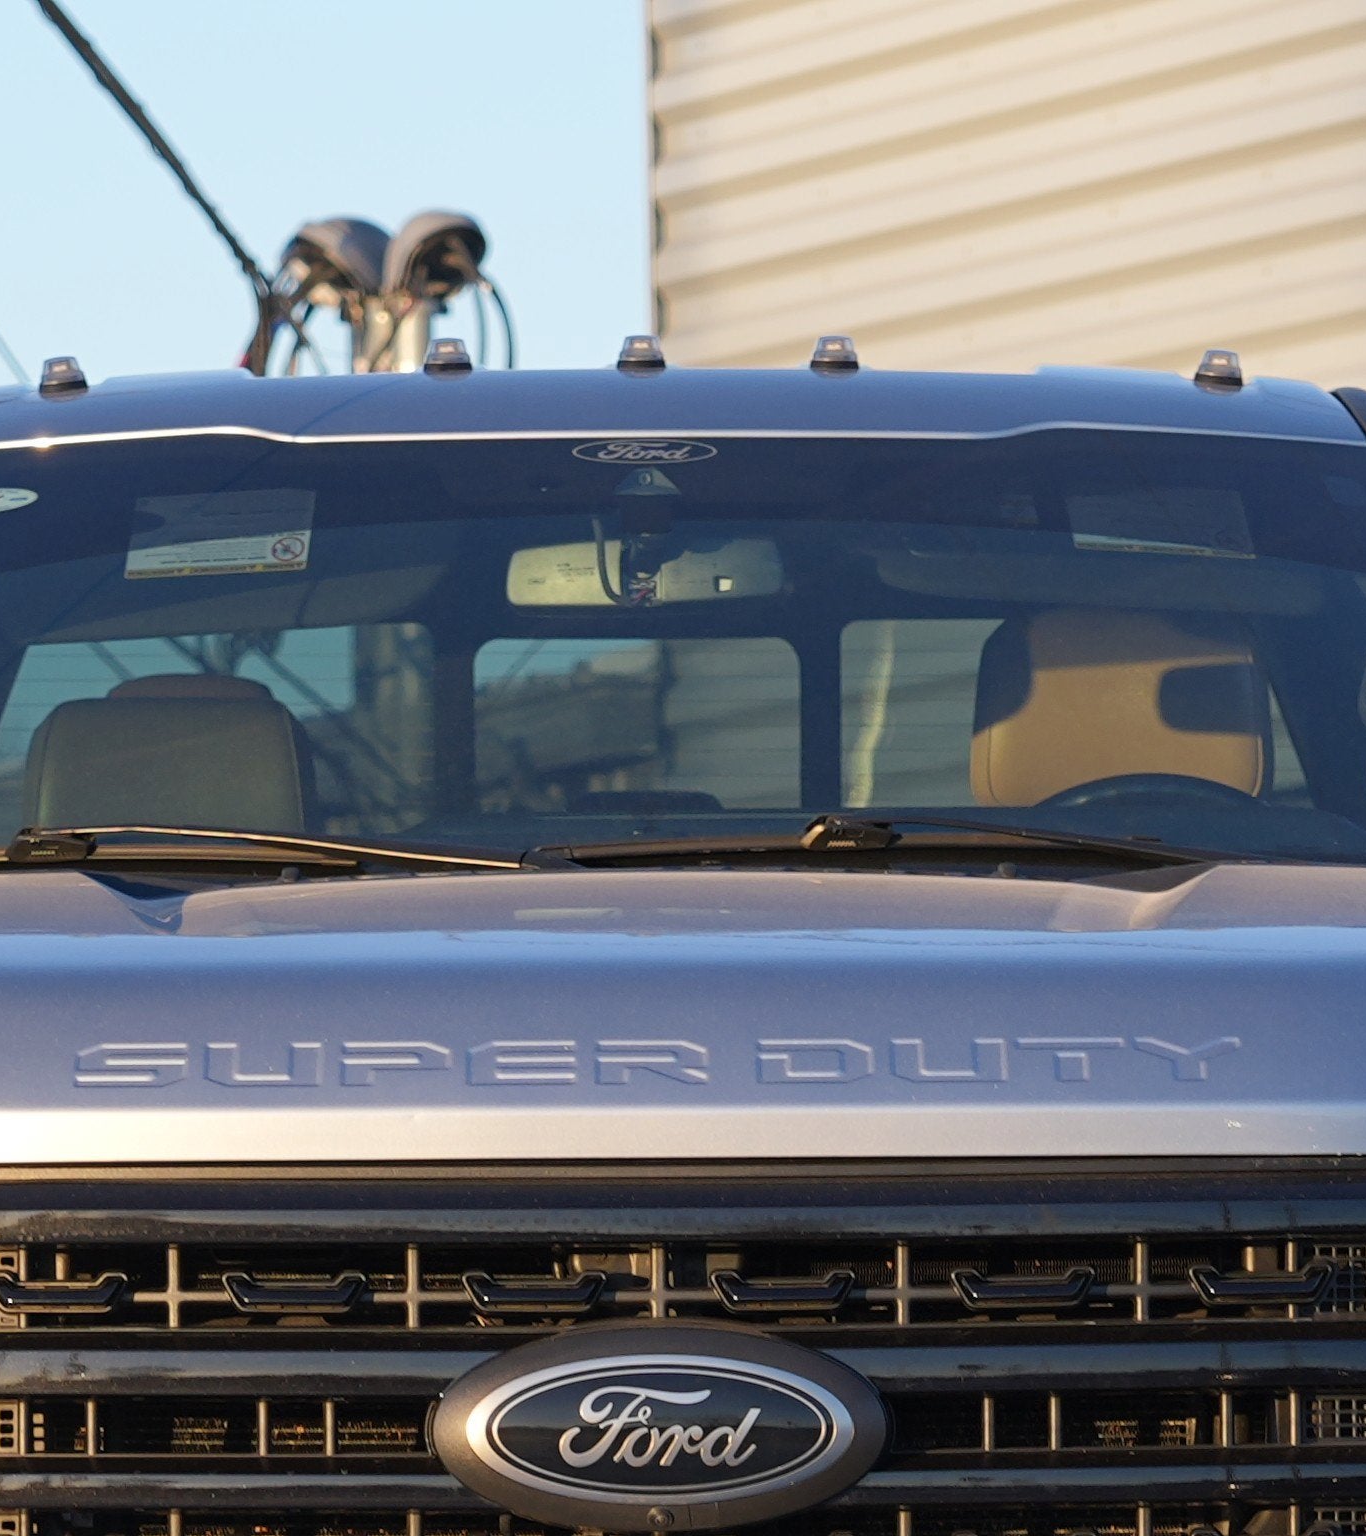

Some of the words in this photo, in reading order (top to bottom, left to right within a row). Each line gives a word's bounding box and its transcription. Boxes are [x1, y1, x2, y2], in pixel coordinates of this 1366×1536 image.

[597, 442, 691, 460] Ford
[73, 1038, 708, 1087] SUPER
[755, 1036, 1241, 1084] DUTY
[558, 1384, 762, 1468] Ford
